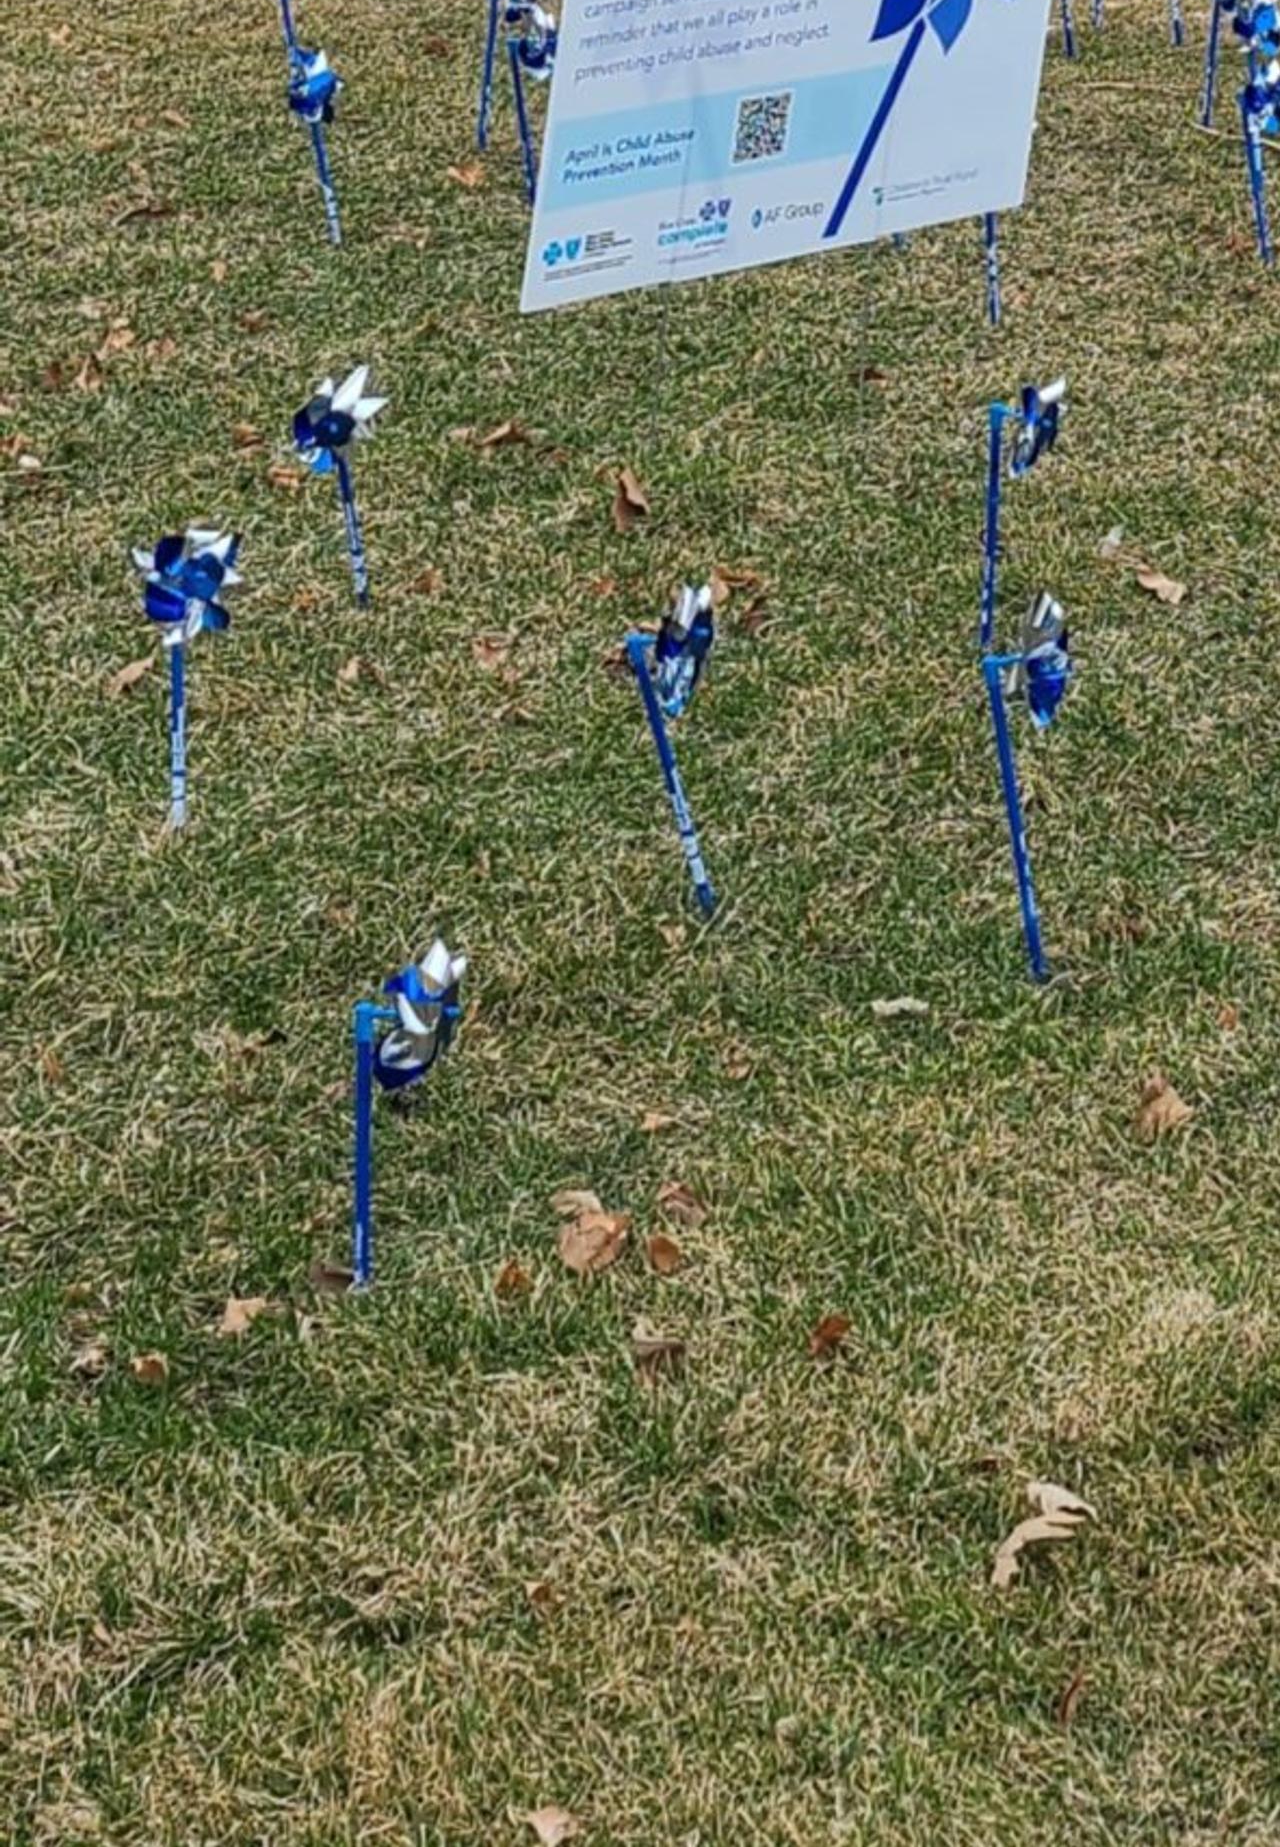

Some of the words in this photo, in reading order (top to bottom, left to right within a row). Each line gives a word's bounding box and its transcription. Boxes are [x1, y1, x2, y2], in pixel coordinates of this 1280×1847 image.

[578, 25, 648, 51] reminder
[650, 19, 680, 39] that
[682, 16, 705, 31] we
[707, 9, 724, 29] all
[726, 8, 759, 29] play
[762, 5, 772, 20] a
[573, 53, 655, 84] preventing
[657, 44, 694, 67] child
[696, 38, 742, 61] abuse
[744, 29, 774, 51] and
[566, 144, 600, 165] April
[616, 134, 652, 155] Child
[653, 129, 696, 148] Abuse
[562, 159, 635, 185] Prevention
[637, 149, 682, 170] Month
[763, 207, 783, 224] AF
[784, 202, 825, 223] Group
[657, 219, 729, 247] complete
